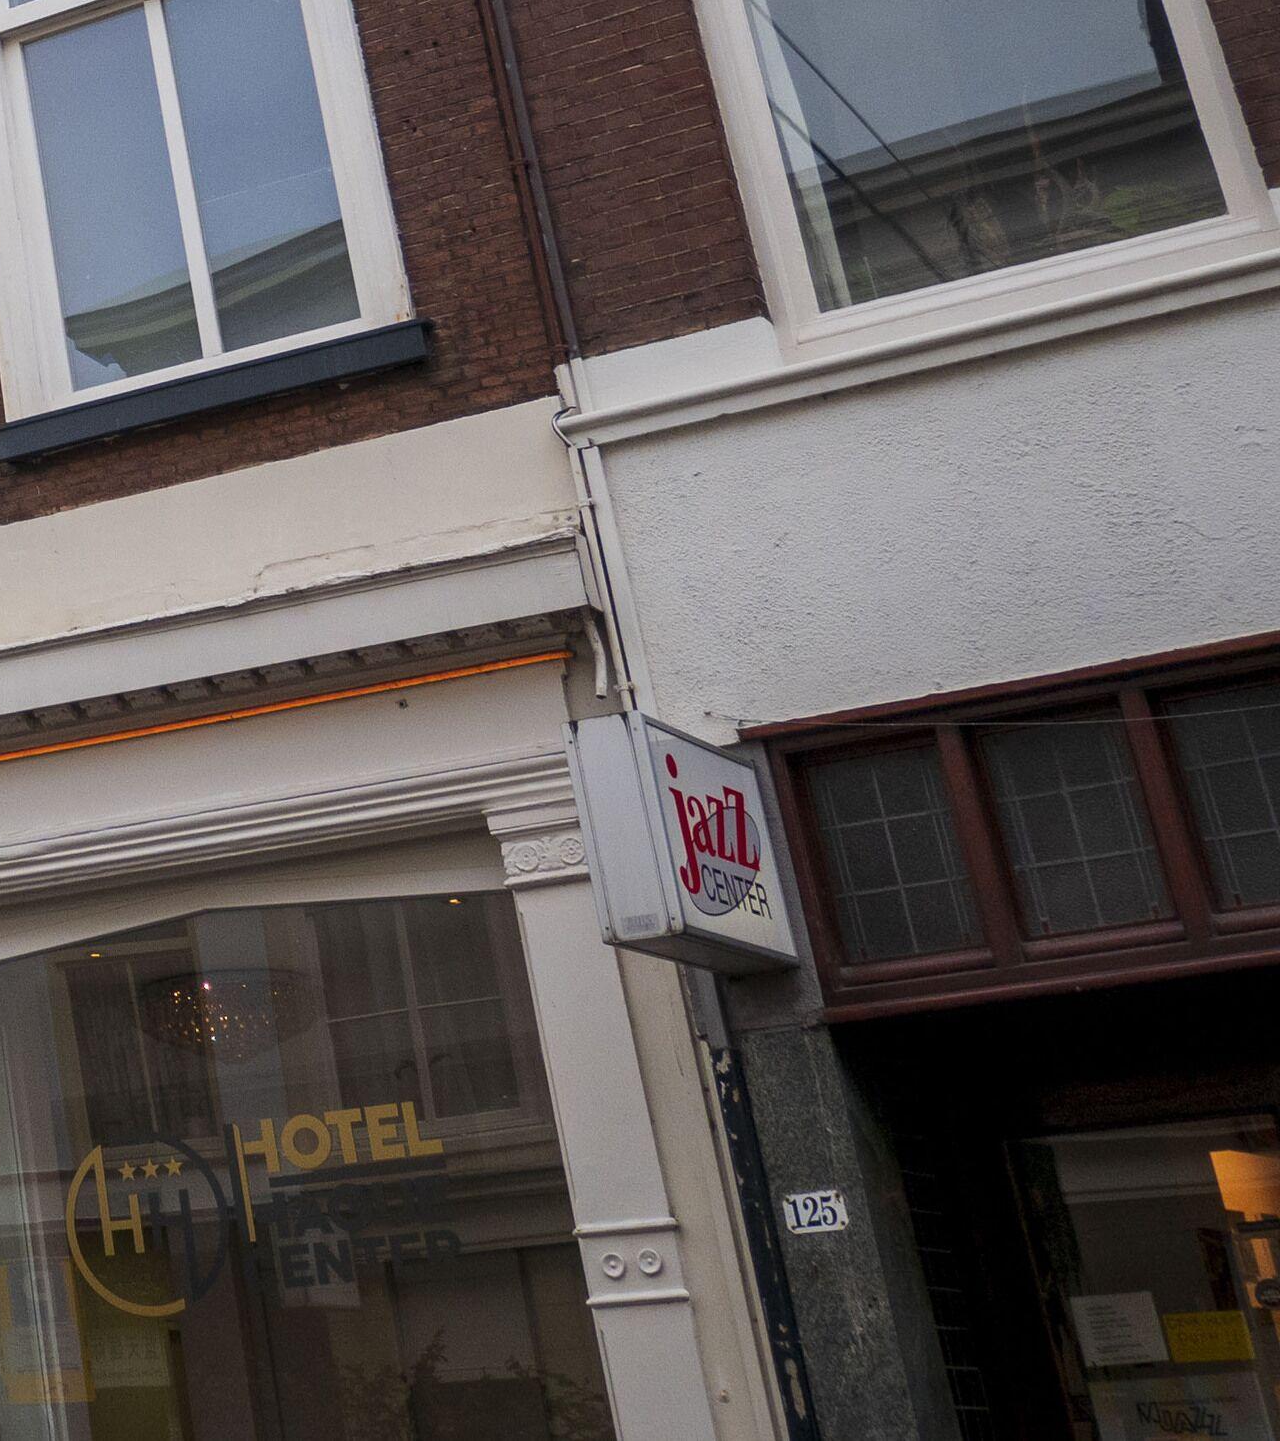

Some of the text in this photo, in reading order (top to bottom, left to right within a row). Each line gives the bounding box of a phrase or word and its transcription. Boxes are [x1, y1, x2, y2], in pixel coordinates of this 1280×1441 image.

[700, 863, 774, 921] CENTER
[233, 1101, 445, 1174] HOTEL
[788, 1195, 838, 1229] 125
[244, 1229, 463, 1298] ENTER
